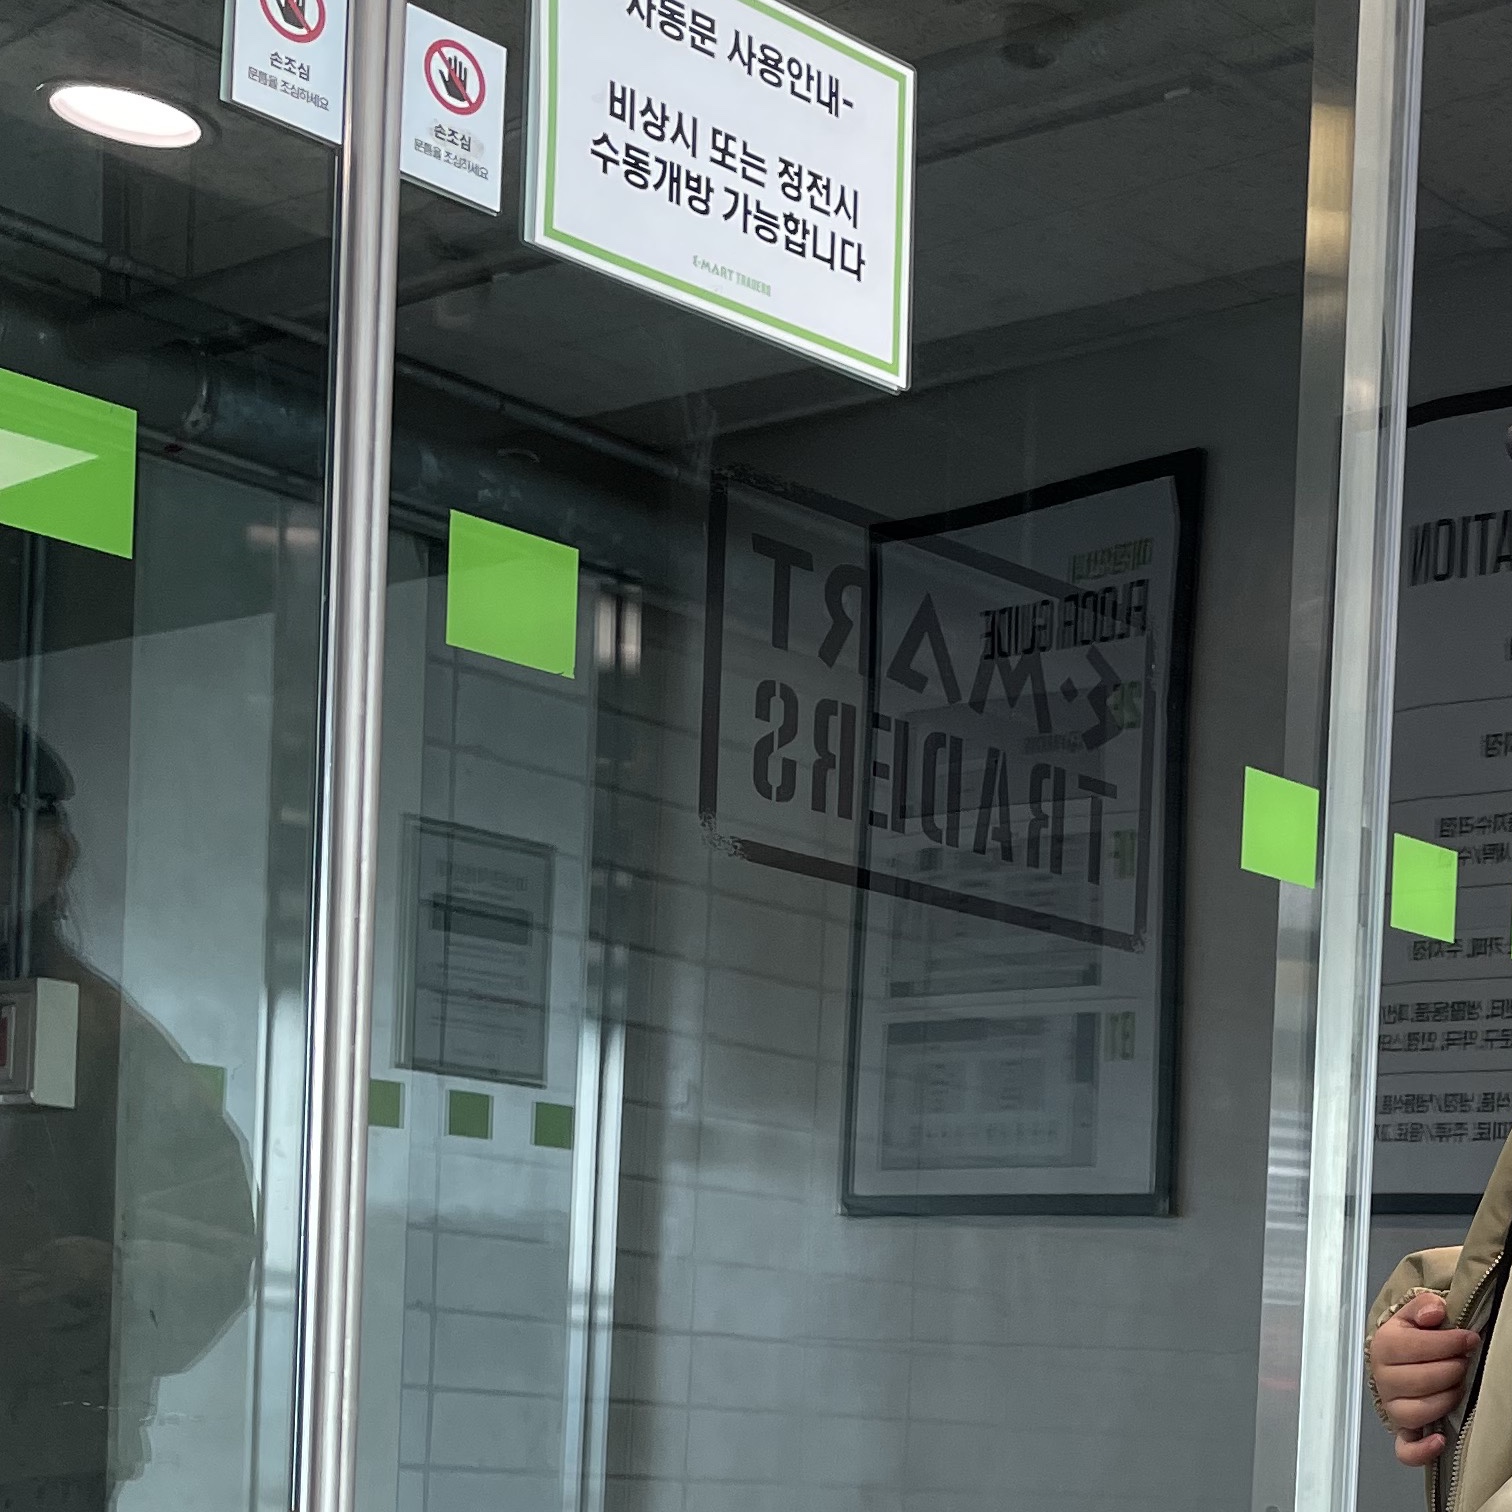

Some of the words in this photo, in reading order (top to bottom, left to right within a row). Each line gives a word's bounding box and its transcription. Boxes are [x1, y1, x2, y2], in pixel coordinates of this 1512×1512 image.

[269, 51, 311, 82] 손조심
[280, 79, 330, 112] 조심하세요
[433, 124, 472, 153] 손조심
[608, 79, 698, 159] 비상시
[709, 126, 768, 188] 또는
[777, 156, 859, 230] 정전시
[443, 152, 490, 182] 조심하세요
[589, 132, 715, 216] 수동개방
[722, 186, 866, 283] 가능합니다
